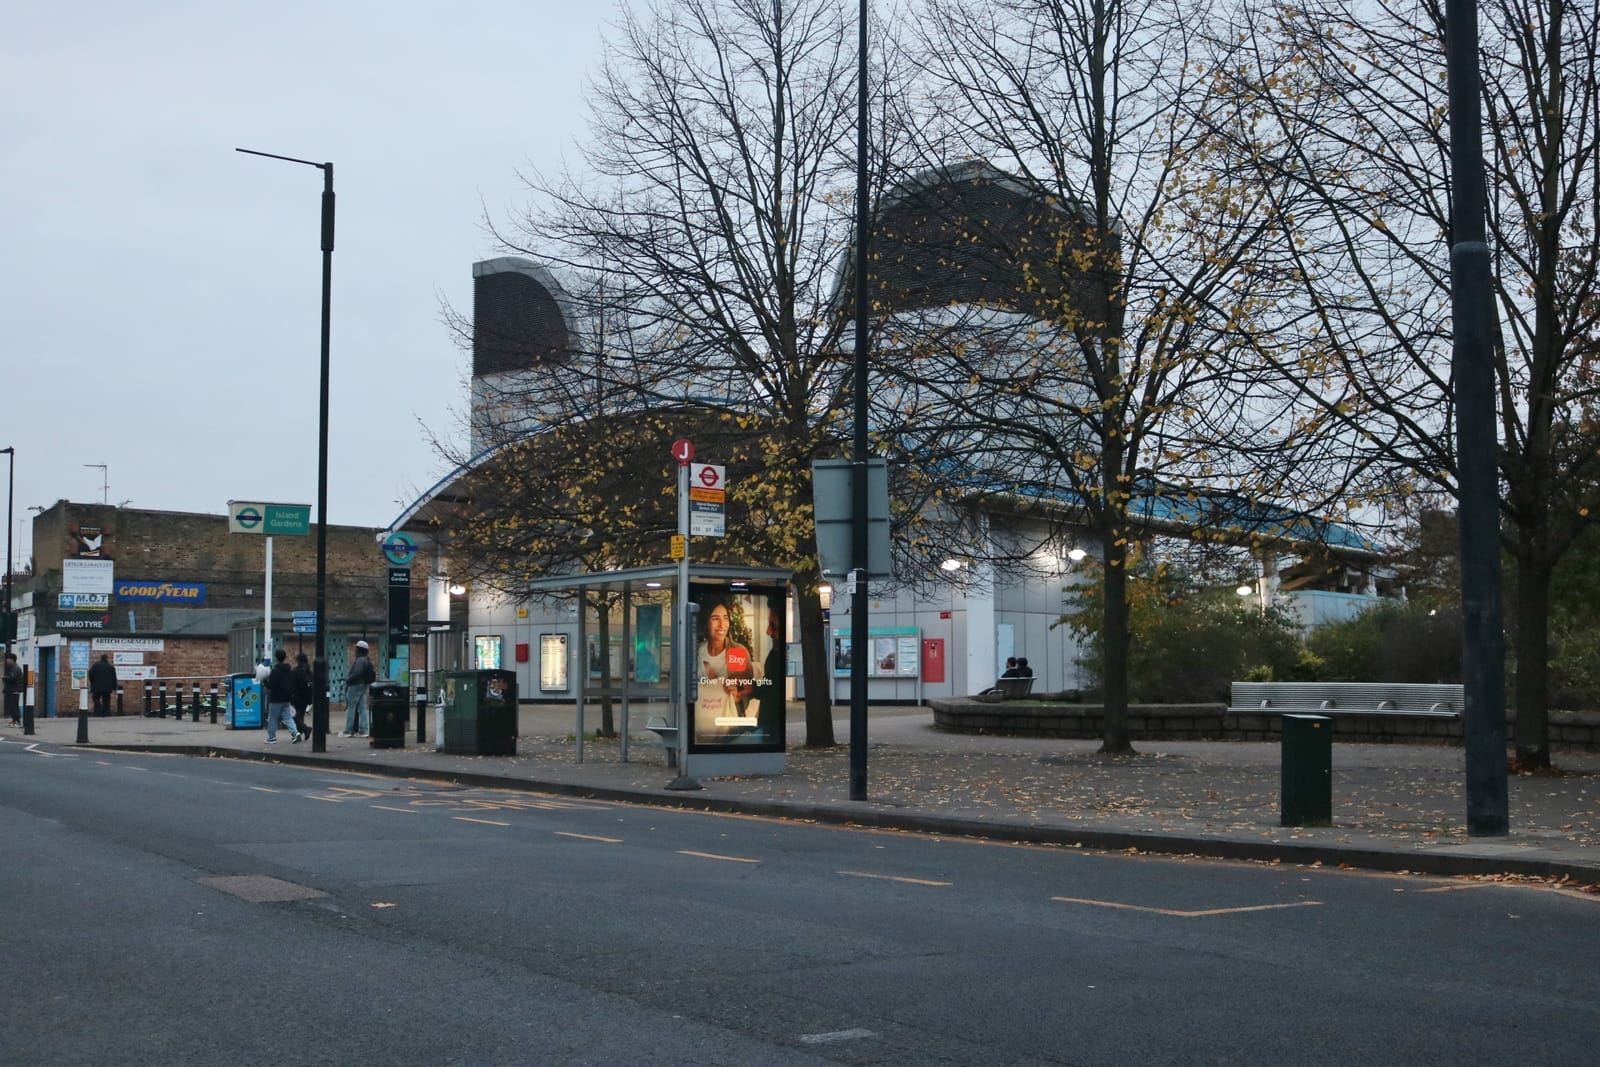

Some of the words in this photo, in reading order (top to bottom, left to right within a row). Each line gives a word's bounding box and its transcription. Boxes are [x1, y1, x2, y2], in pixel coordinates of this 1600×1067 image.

[679, 442, 689, 459] J
[728, 655, 745, 665] Etsy
[700, 677, 717, 685] Give
[725, 678, 737, 686] get
[756, 678, 772, 686] gifts
